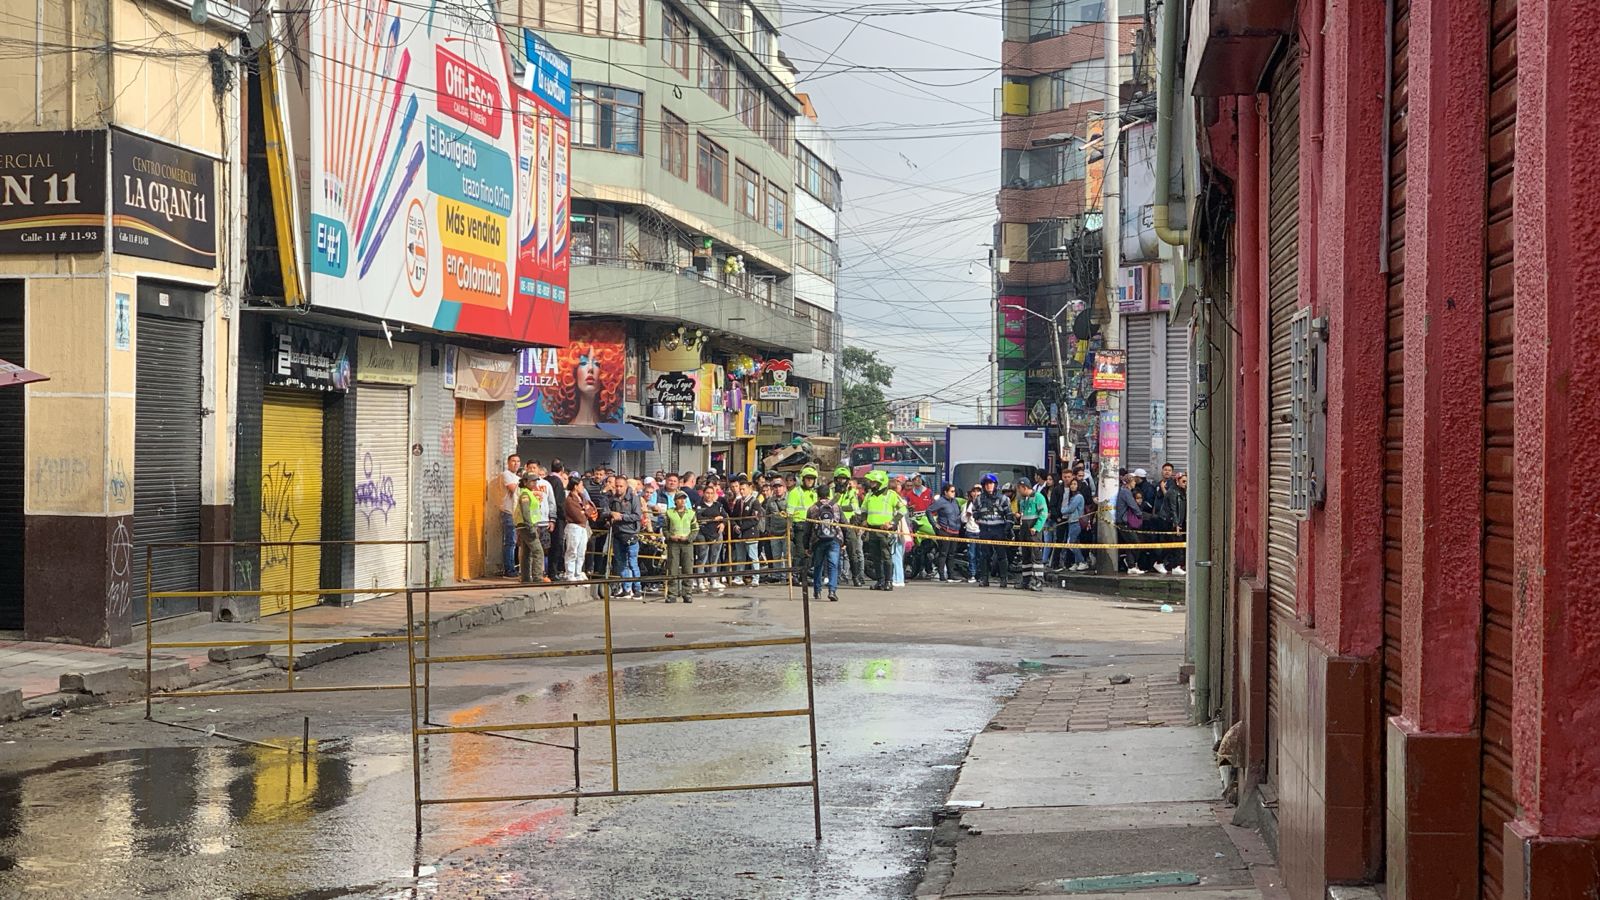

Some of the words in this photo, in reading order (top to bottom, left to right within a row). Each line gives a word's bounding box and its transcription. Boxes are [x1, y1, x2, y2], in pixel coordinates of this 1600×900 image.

[430, 123, 438, 153] El
[439, 129, 477, 169] Bolígrafo
[132, 156, 161, 177] CENTRO
[160, 164, 198, 187] COMERCIAL
[44, 172, 81, 205] 11
[124, 174, 147, 209] LA
[148, 181, 191, 221] GRAN
[193, 192, 208, 223] 11
[462, 173, 480, 199] trazo
[480, 178, 494, 204] fino
[21, 233, 43, 242] Calle
[45, 232, 56, 242] 11
[59, 232, 68, 242] #
[70, 231, 98, 241] 11-93
[446, 204, 465, 236] Más
[467, 215, 501, 246] vendido
[317, 222, 327, 249] El
[327, 226, 341, 264] #1
[447, 254, 457, 275] en
[457, 256, 502, 295] Colombia
[519, 375, 559, 387] BELLEZA
[674, 378, 693, 392] Toys
